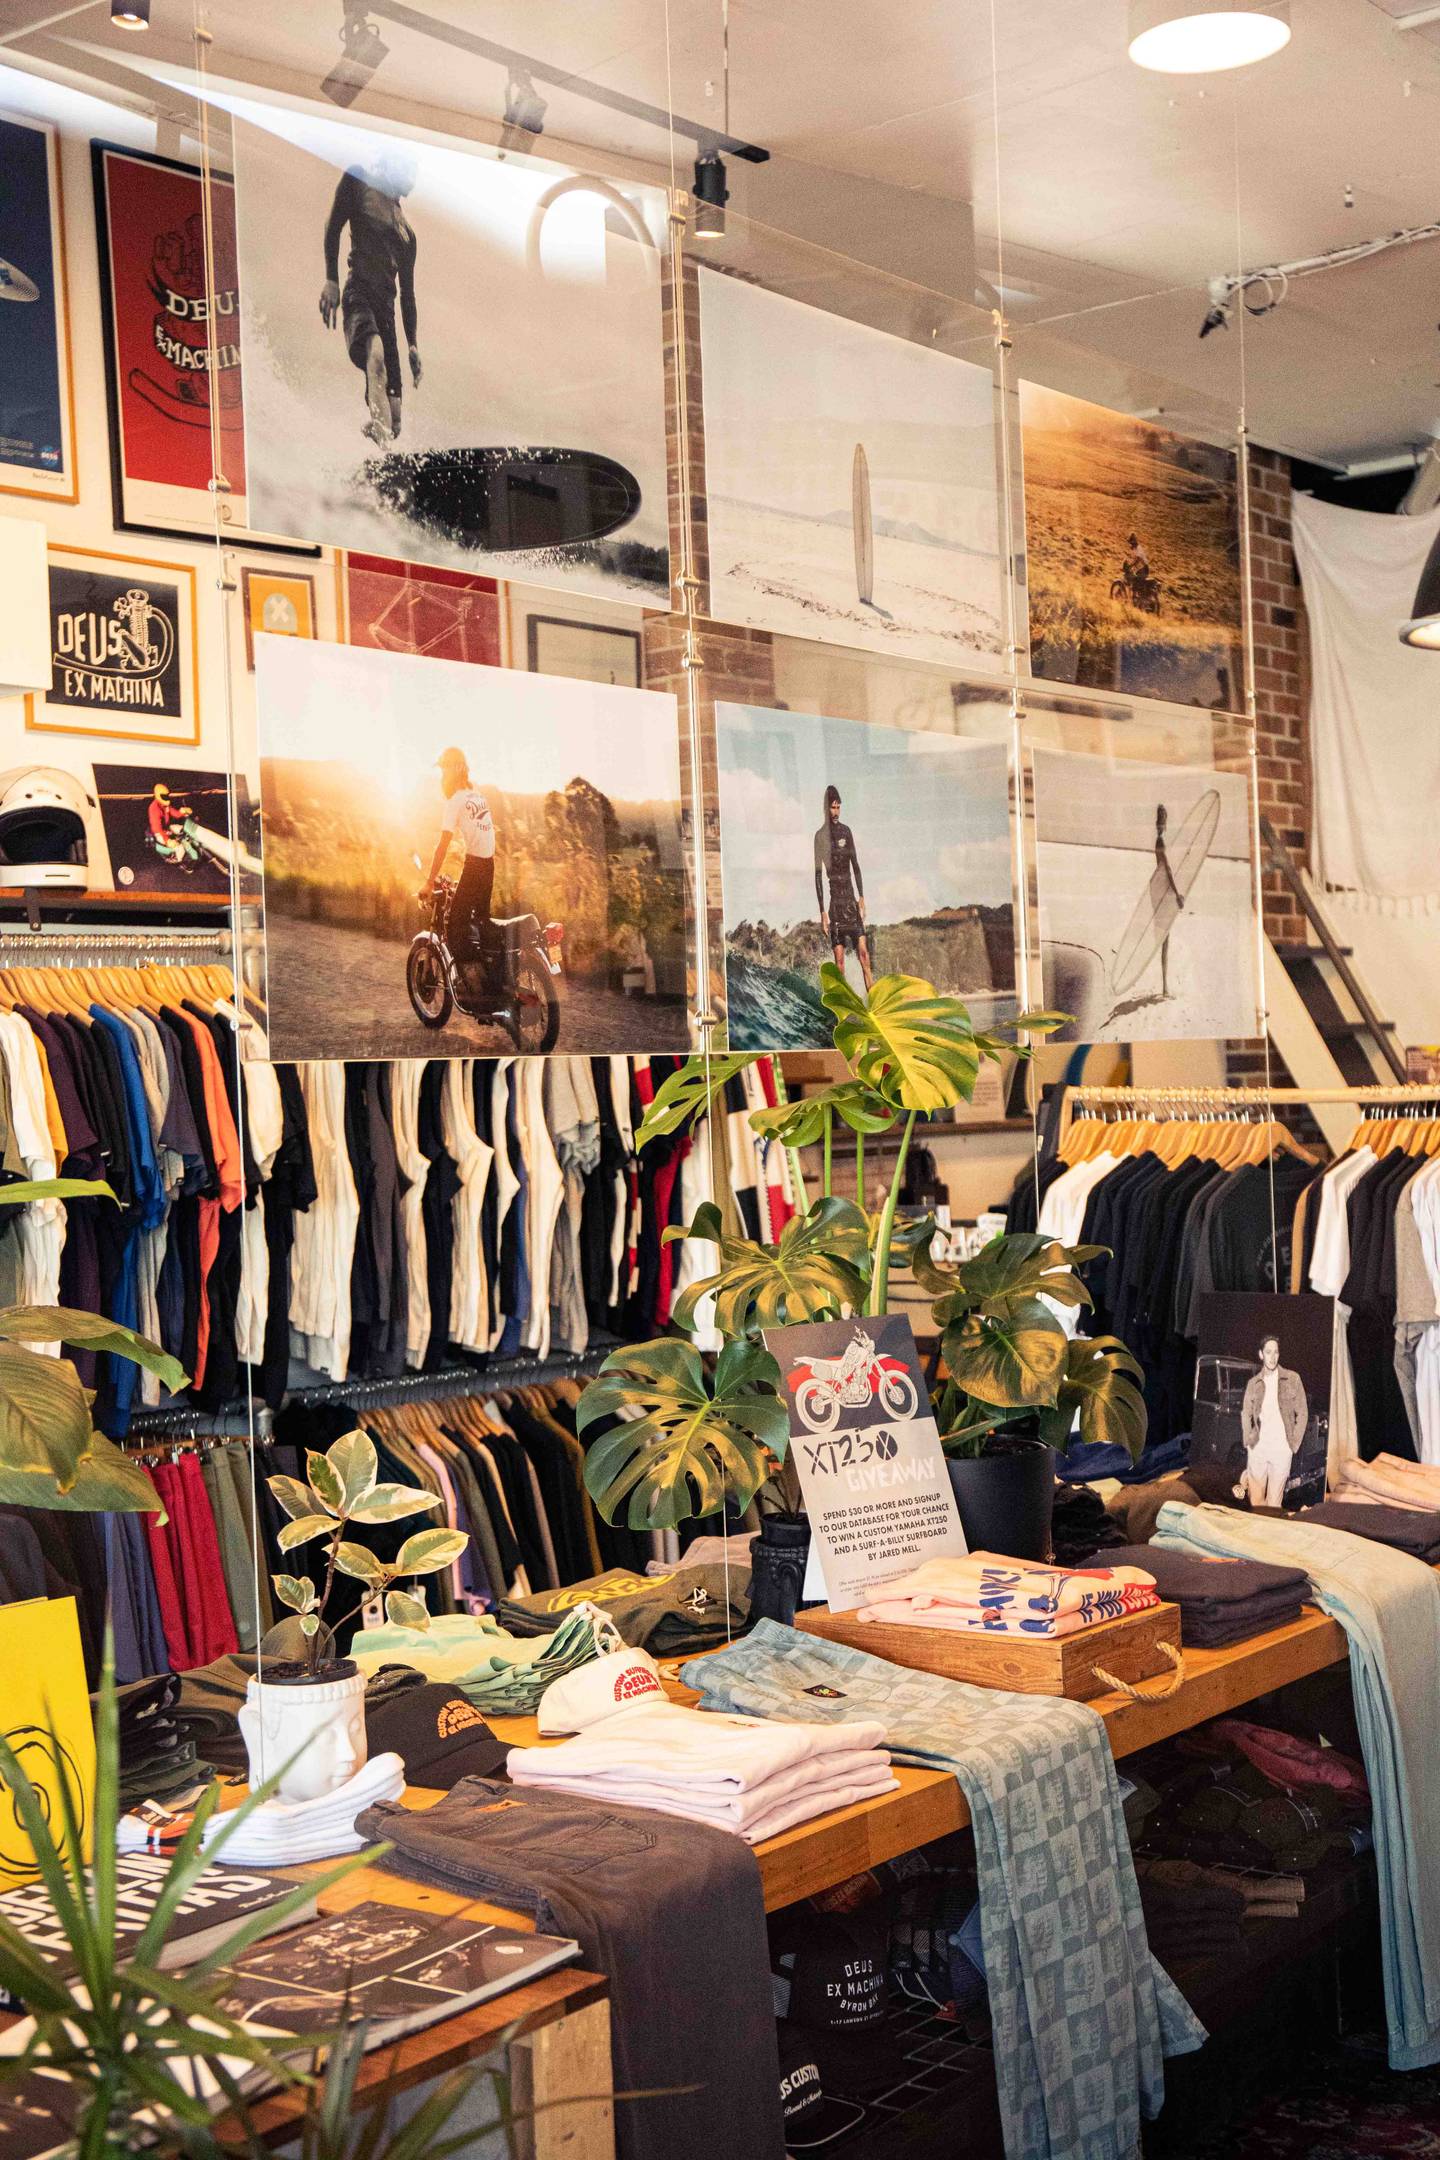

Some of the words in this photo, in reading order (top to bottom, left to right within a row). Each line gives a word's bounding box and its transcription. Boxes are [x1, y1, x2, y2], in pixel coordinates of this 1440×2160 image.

[166, 289, 239, 320] DEU
[165, 337, 240, 370] MACHIN
[58, 612, 122, 665] DEUS
[65, 669, 87, 697] EX
[91, 675, 164, 707] MACHINA
[803, 1426, 898, 1476] XT250
[846, 1456, 936, 1491] GIVEAWAY
[819, 1525, 829, 1533] TO
[831, 1521, 848, 1531] OUR
[849, 1515, 884, 1528] DATABASE
[886, 1512, 900, 1520] FOR
[901, 1508, 920, 1518] YOUR
[922, 1503, 949, 1515] CHANCE
[823, 1510, 847, 1520] SPEND
[849, 1507, 862, 1517] $30
[864, 1504, 874, 1513] OR
[876, 1501, 896, 1511] MORE
[898, 1498, 913, 1507] AND
[915, 1493, 941, 1504] SIGNUP
[827, 1536, 837, 1544] TO
[839, 1533, 855, 1542] WIN
[864, 1526, 893, 1537] CUSTOM
[895, 1519, 925, 1532] YAMAHA
[927, 1515, 947, 1525] XT250
[834, 1546, 850, 1555] AND
[852, 1543, 857, 1552] A
[859, 1536, 904, 1551] SURF-A-BILLY
[907, 1527, 947, 1542] SURFBOARD
[868, 1553, 877, 1561] BY
[879, 1548, 900, 1559] JARED
[902, 1545, 920, 1554] MELL.
[613, 1673, 627, 1701] CUSTOM
[844, 1959, 873, 1977] DEUS
[827, 1983, 842, 1997] EX
[847, 1974, 884, 1996] MACHINA
[840, 1999, 867, 2012] BYRON
